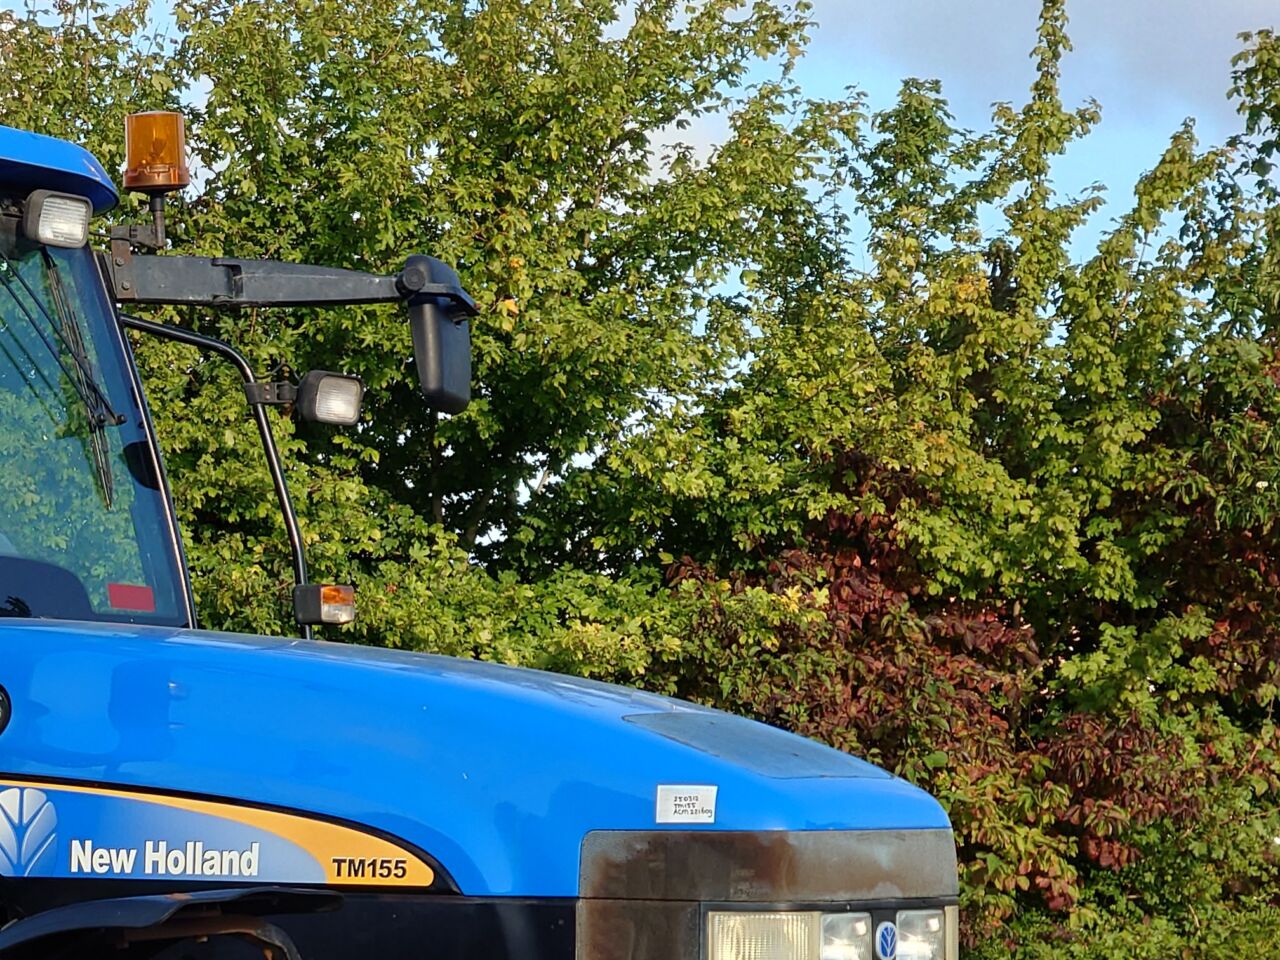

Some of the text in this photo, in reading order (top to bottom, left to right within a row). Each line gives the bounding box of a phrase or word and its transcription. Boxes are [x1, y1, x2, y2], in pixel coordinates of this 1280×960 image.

[70, 839, 260, 877] New Holland
[332, 858, 408, 880] TM155
